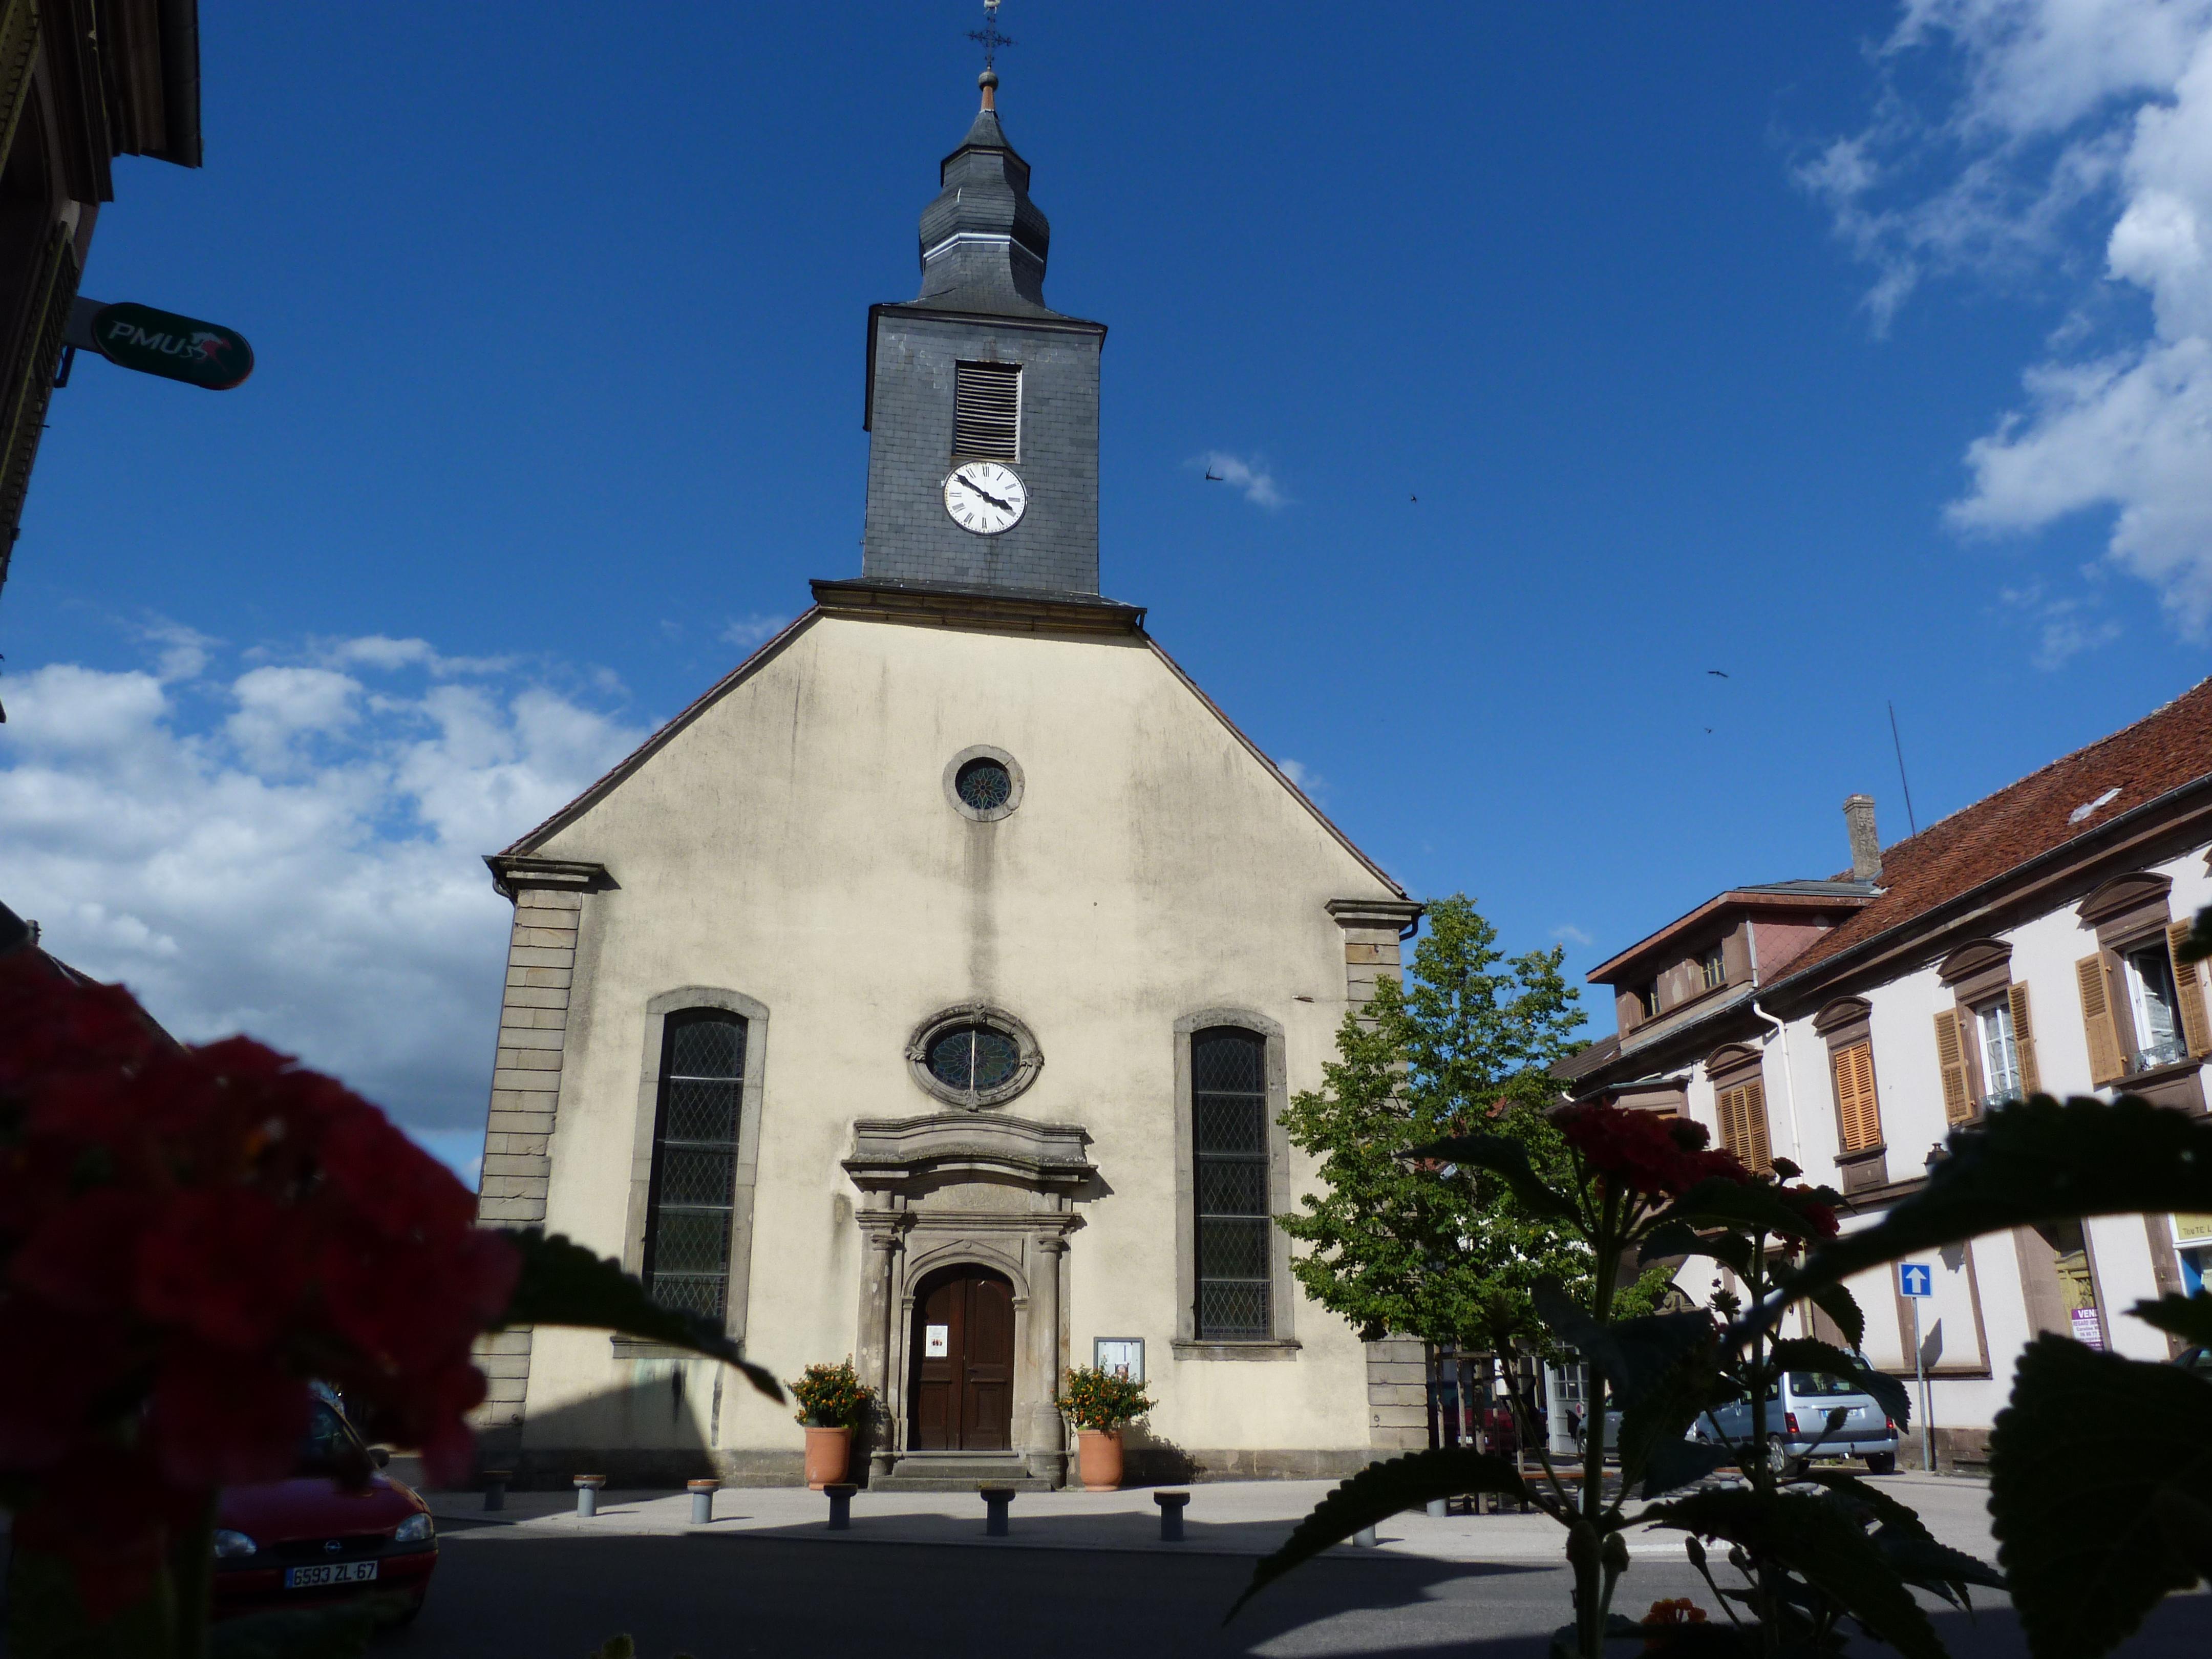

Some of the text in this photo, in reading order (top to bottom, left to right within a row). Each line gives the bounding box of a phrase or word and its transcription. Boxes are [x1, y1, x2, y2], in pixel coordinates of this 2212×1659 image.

[108, 321, 186, 354] PMU
[2182, 1226, 2204, 1235] TOUTE
[294, 1563, 376, 1585] 6593 ZL 67
